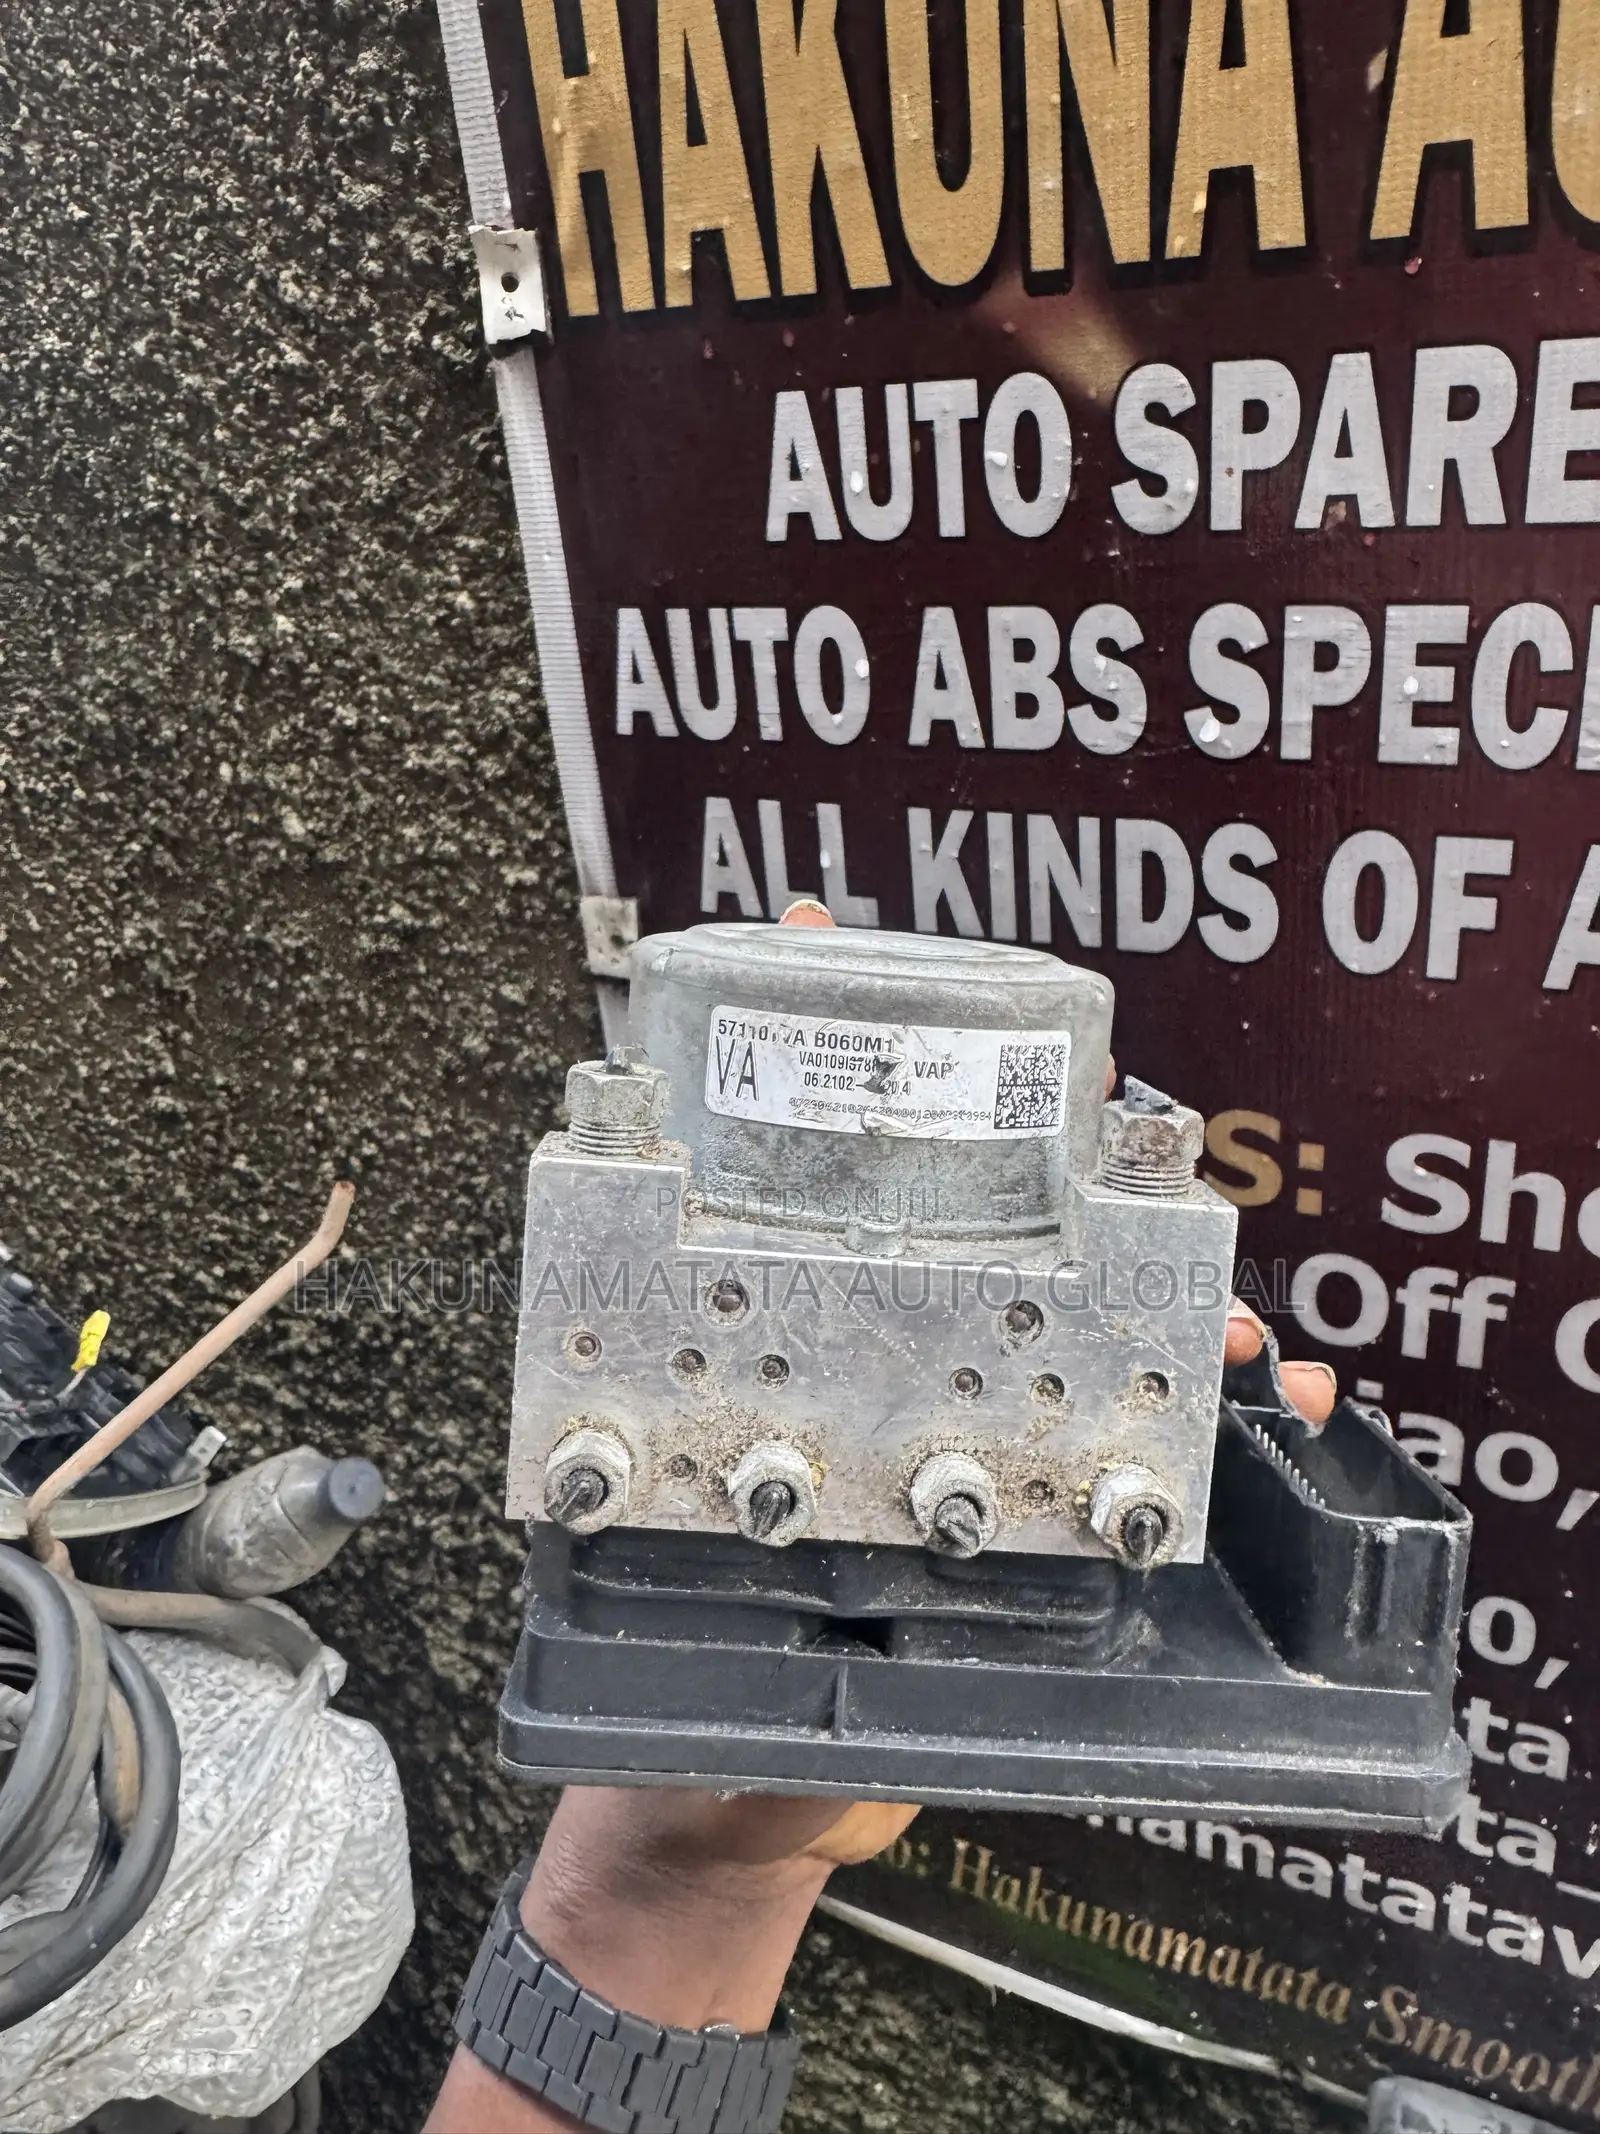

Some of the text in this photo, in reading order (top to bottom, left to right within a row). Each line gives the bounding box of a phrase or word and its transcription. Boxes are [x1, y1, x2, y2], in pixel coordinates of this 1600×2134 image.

[522, 0, 1306, 317] HAKUNA
[765, 372, 1073, 542] AUTO
[615, 604, 871, 746] AUTO
[907, 603, 1148, 755] ABS
[700, 796, 879, 928] ALL
[907, 807, 1279, 964] KINDS
[1322, 829, 1514, 980] OF
[715, 1036, 760, 1101] VA
[1380, 1133, 1600, 1260] Sh
[1291, 1252, 1517, 1369] Off
[947, 1834, 1353, 2026] Hakunamatata
